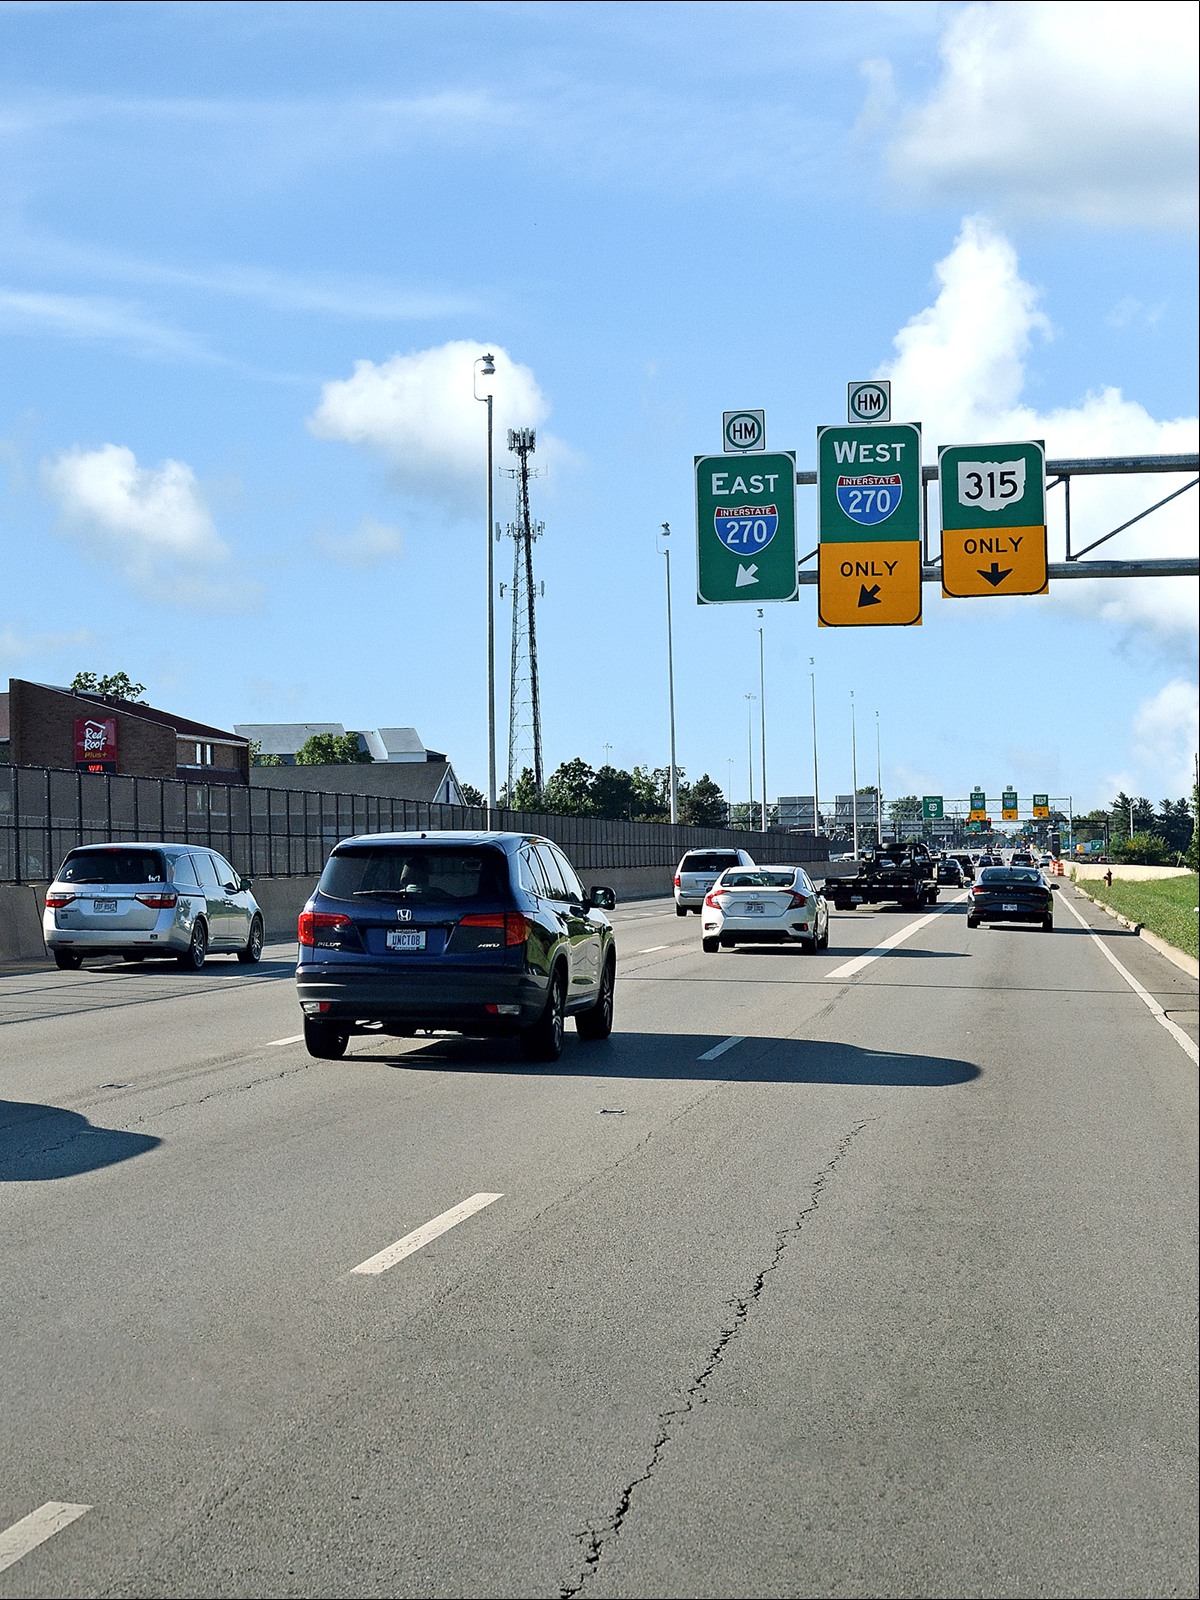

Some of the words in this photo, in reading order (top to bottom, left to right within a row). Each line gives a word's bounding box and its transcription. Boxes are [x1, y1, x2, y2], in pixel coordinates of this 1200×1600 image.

[857, 393, 881, 411] HM
[732, 422, 756, 440] HM
[833, 441, 906, 464] WEST
[711, 472, 779, 496] EAST
[843, 476, 896, 486] INTERSTATE
[964, 470, 1018, 500] 315
[849, 489, 891, 514] 270
[720, 507, 772, 517] INTERSTATE
[726, 520, 768, 544] 270
[964, 536, 1024, 555] ONLY
[840, 560, 899, 577] ONLY
[85, 728, 103, 740] Red
[84, 737, 107, 751] Roof
